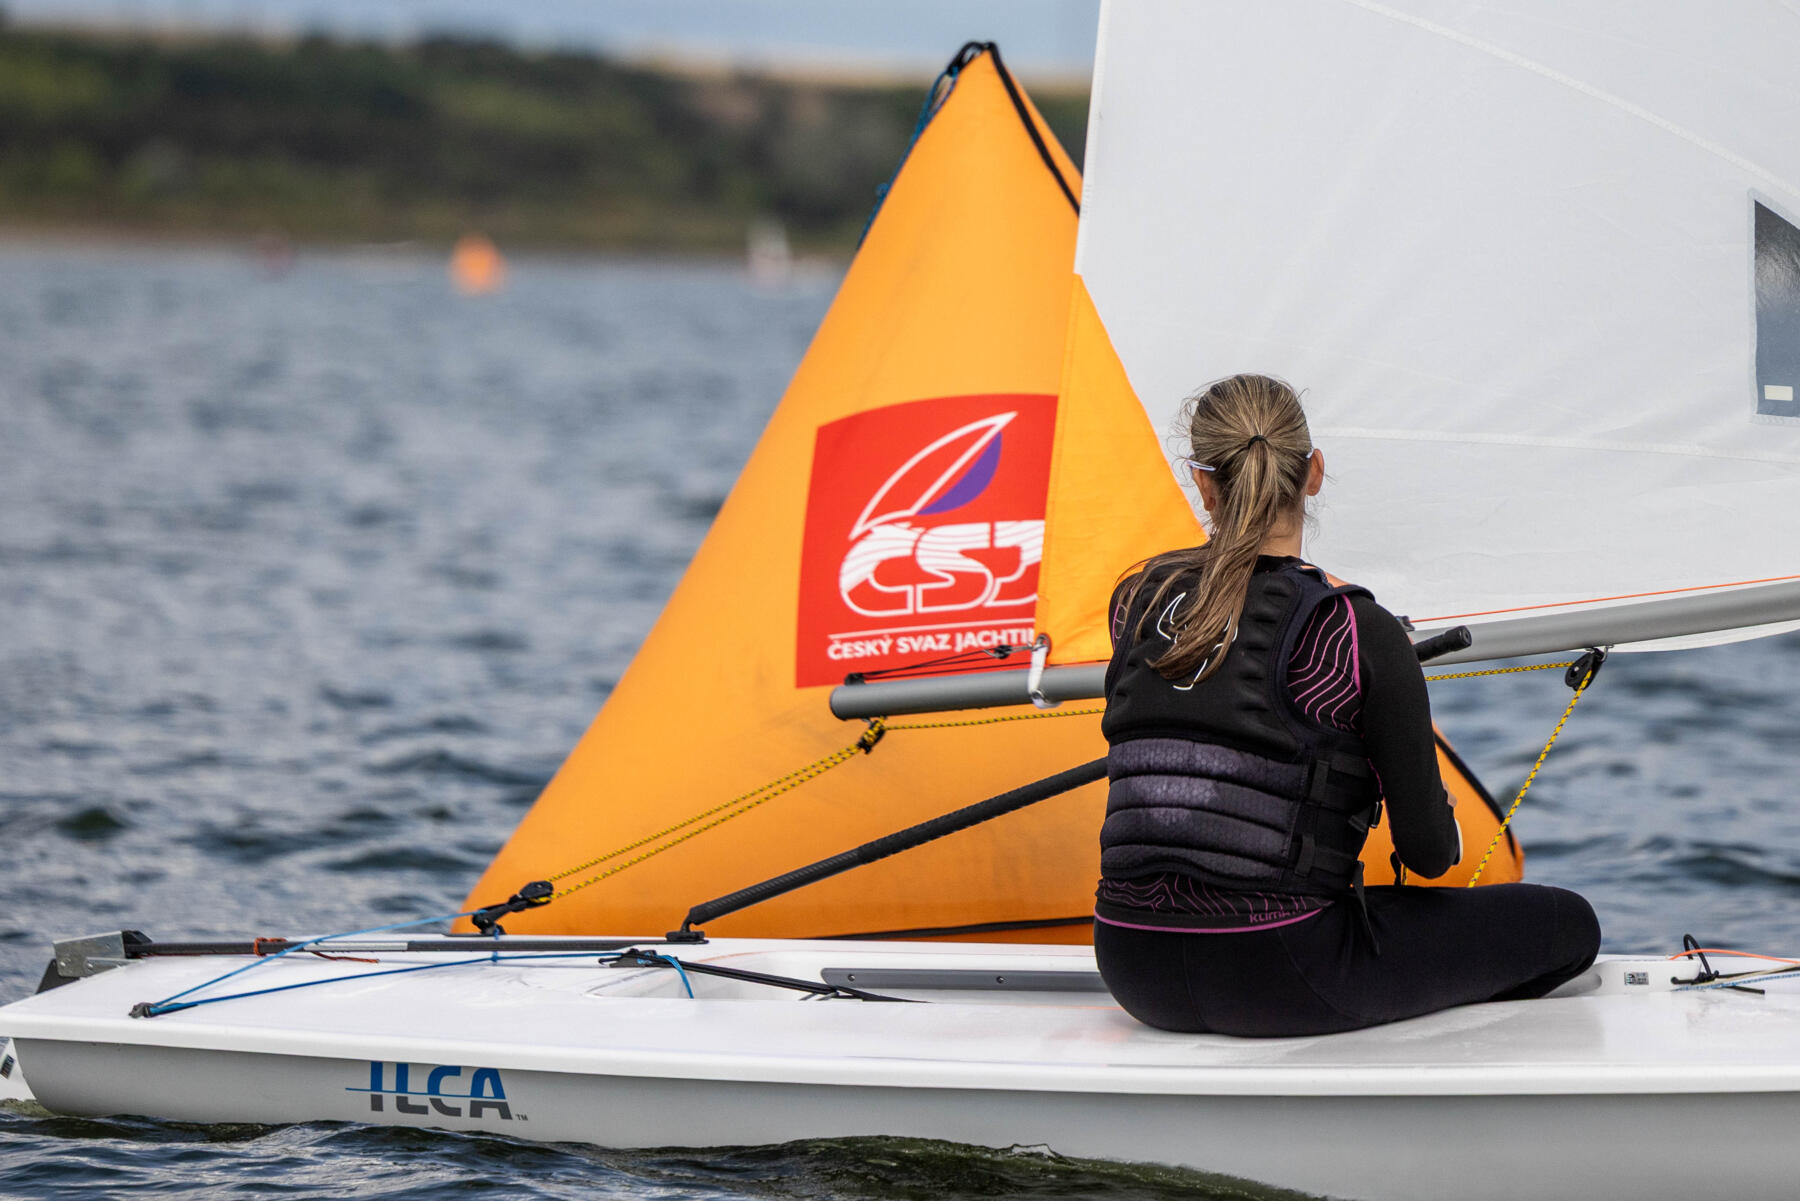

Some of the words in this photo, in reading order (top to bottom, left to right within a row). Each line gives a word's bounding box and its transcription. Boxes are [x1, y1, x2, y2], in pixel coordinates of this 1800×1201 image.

[827, 635, 892, 660] ČESKÝ
[897, 633, 951, 653] SVAZ
[370, 1060, 513, 1121] ILCA
